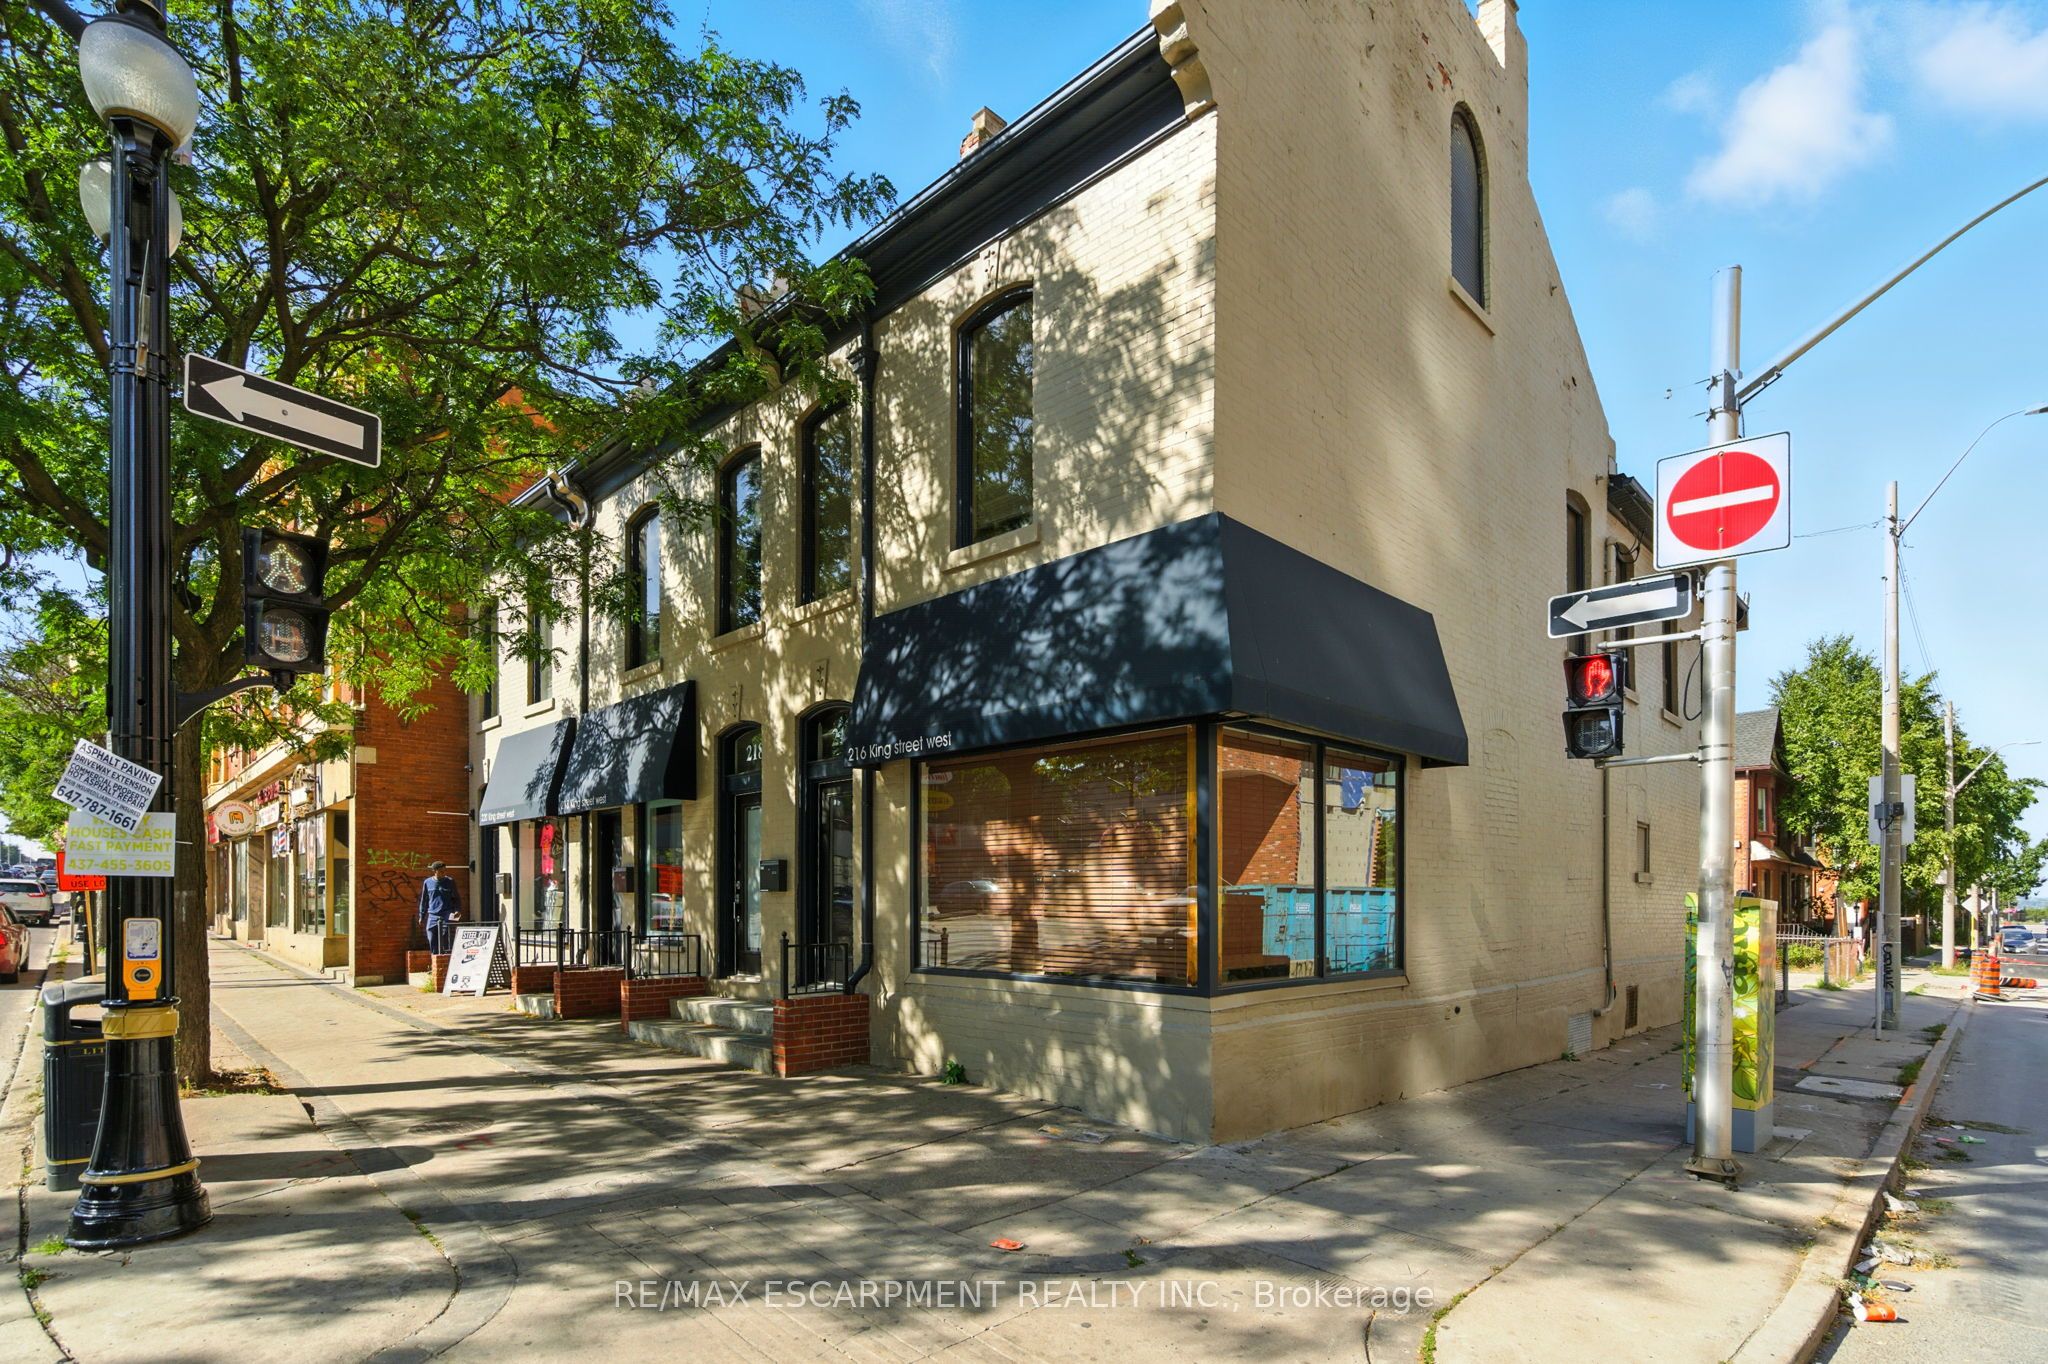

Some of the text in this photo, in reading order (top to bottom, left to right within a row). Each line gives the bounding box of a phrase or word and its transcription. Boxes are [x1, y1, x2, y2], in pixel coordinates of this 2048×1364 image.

[848, 731, 952, 761] 216 King street west
[74, 754, 153, 795] DRIVEWAY EXTENSION
[80, 743, 158, 785] ASPHALT PAVING
[67, 769, 145, 809] HOT ASPHALT REPAIR
[70, 763, 148, 803] COMMERCIAL PROPERTY
[56, 785, 137, 831] 647-787-1661
[69, 841, 173, 853] FAST PAYMENT
[70, 826, 128, 839] HOUSES
[67, 858, 172, 872] 437-455-3605
[70, 880, 89, 888] USE
